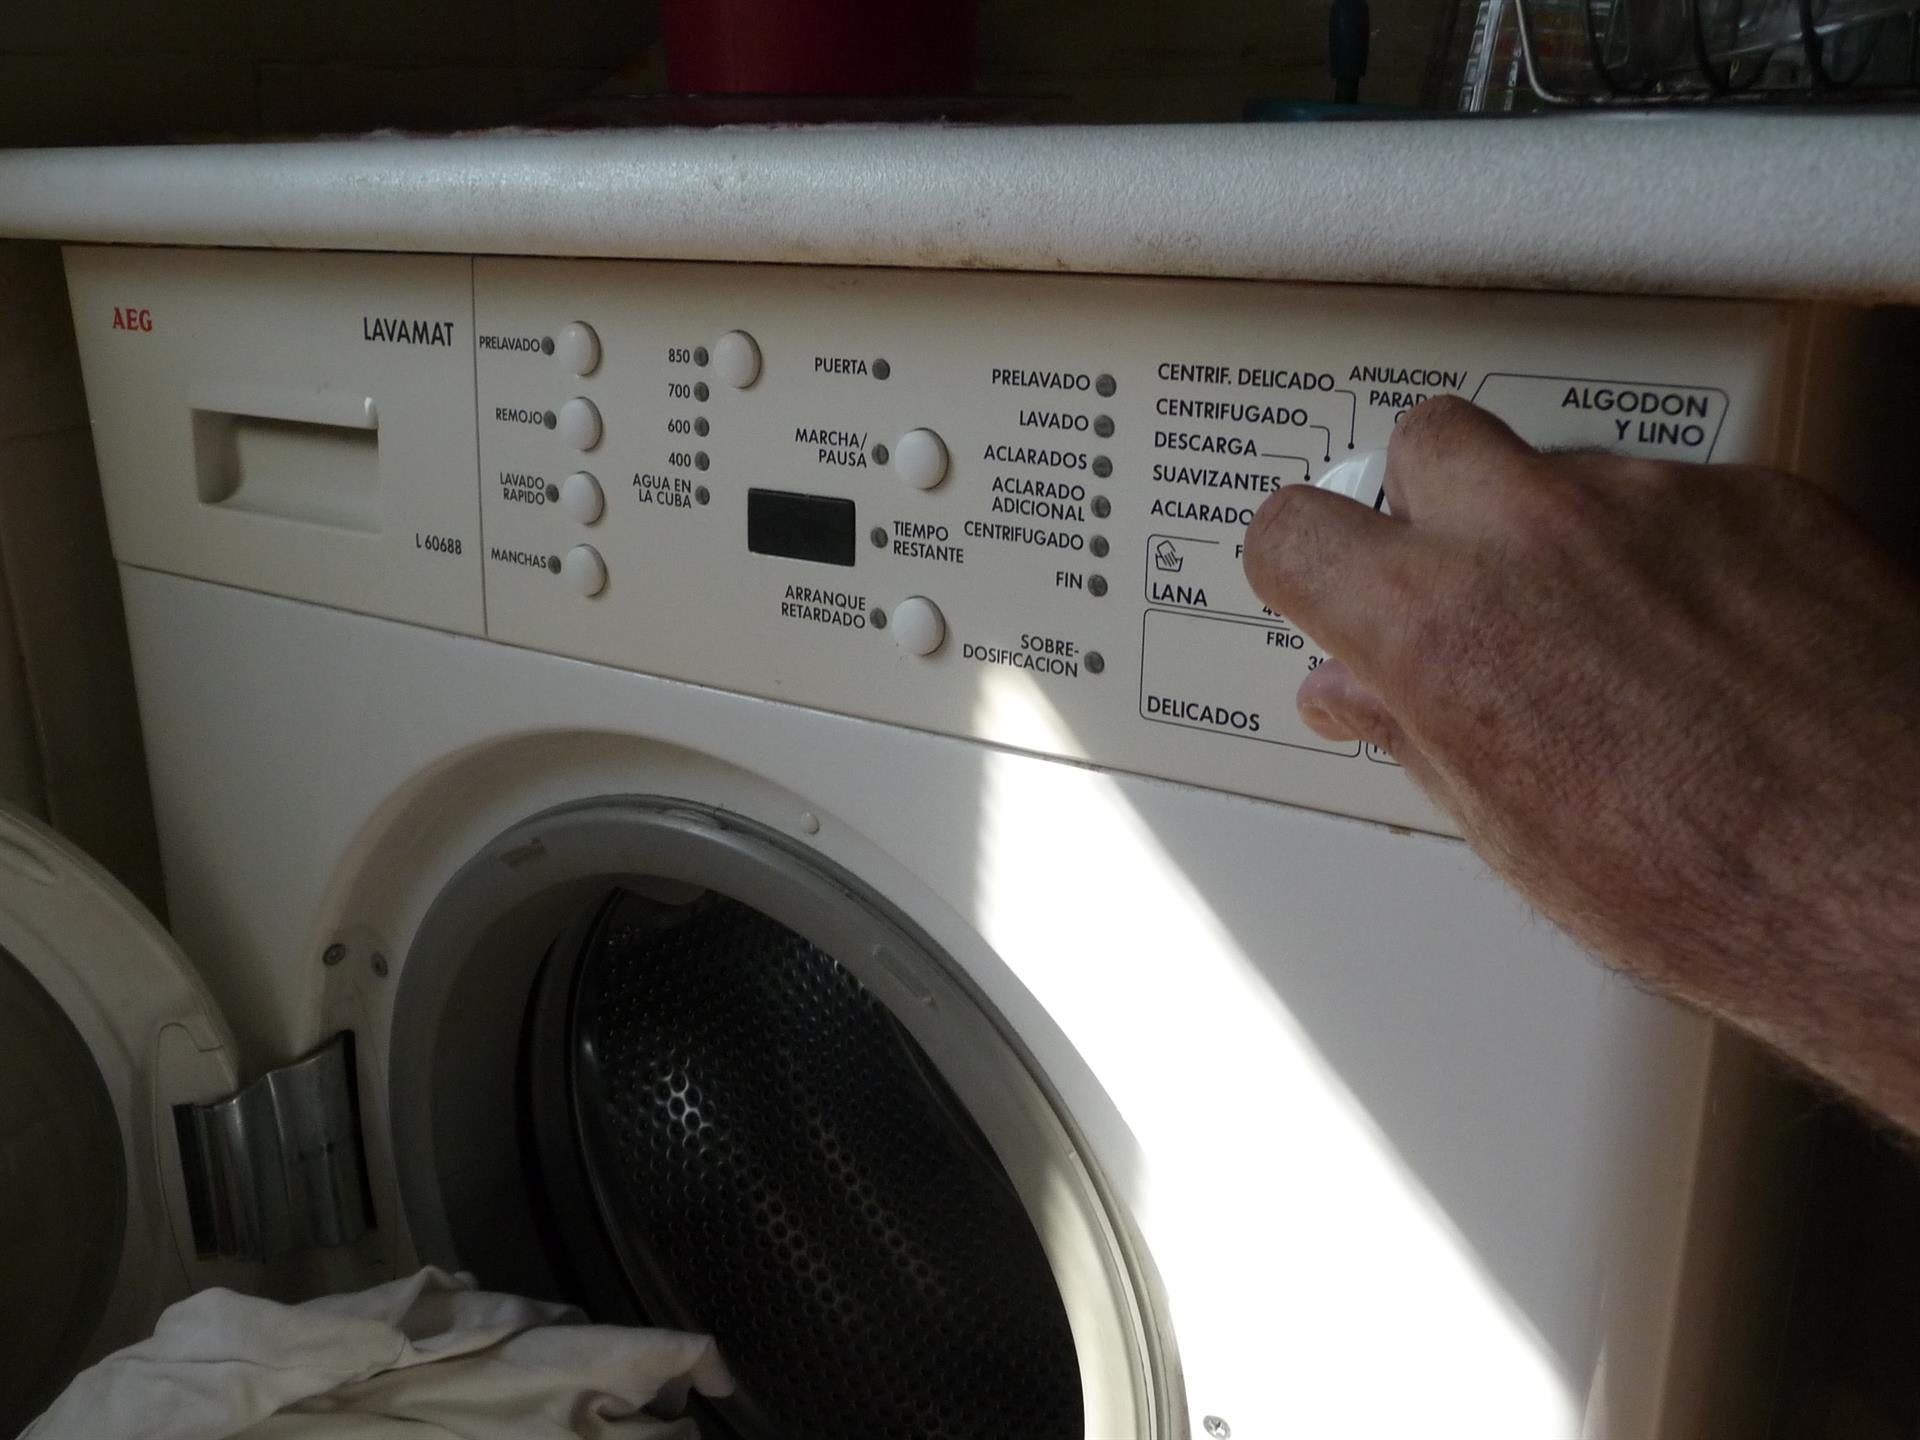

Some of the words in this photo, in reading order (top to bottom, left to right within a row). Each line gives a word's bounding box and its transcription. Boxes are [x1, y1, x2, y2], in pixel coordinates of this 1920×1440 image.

[112, 307, 153, 333] AEG
[363, 317, 454, 347] LAVAMAT
[479, 335, 541, 353] PRELAVADO
[668, 349, 690, 363] 850
[814, 357, 868, 376] PUERTA
[992, 368, 1090, 391] PRELAVADO
[1157, 363, 1232, 385] CENTRIF.
[1238, 368, 1335, 392] DELICADO
[1349, 365, 1468, 391] ANULACION/
[668, 384, 691, 399] 700
[1369, 390, 1430, 408] PARAD
[1561, 386, 1709, 418] ALGODON
[495, 408, 543, 425] REMOJO
[1019, 410, 1089, 432] LAVADO
[1156, 398, 1308, 427] CENTRIFUGADO
[668, 419, 691, 434] 600
[1615, 419, 1631, 441] Y
[1638, 421, 1705, 447] LINO
[795, 428, 868, 450] MARCHA/
[1154, 431, 1257, 457] DESCARGA
[668, 452, 692, 467] 400
[818, 450, 868, 468] PAUSA
[983, 445, 1088, 470] ACLARADOS
[500, 472, 545, 490] LAVADO
[633, 473, 671, 491] AGUA
[674, 479, 692, 493] EN
[992, 476, 1086, 501] ACLARADO
[1152, 464, 1281, 494] SUAVIZANTES
[503, 488, 546, 506] RAPIDO
[639, 489, 654, 503] LA
[656, 491, 692, 509] CUBA
[992, 496, 1086, 523] ADICIONAL
[893, 521, 949, 542] TIEMPO
[964, 520, 1085, 551] CENTRIFUGADO
[415, 533, 423, 549] L
[425, 534, 463, 556] 60688
[893, 540, 964, 564] RESTANTE
[491, 547, 547, 570] MANCHAS
[1055, 571, 1083, 591] FIN
[785, 585, 866, 611] ARRANQUE
[1152, 582, 1208, 608] LANA
[781, 602, 866, 630] RETARDADO
[1020, 634, 1080, 659] SOBRE-
[1267, 631, 1305, 651] FRIO
[962, 643, 1079, 679] DOSIFICACION
[1147, 695, 1261, 732] DELICADOS
